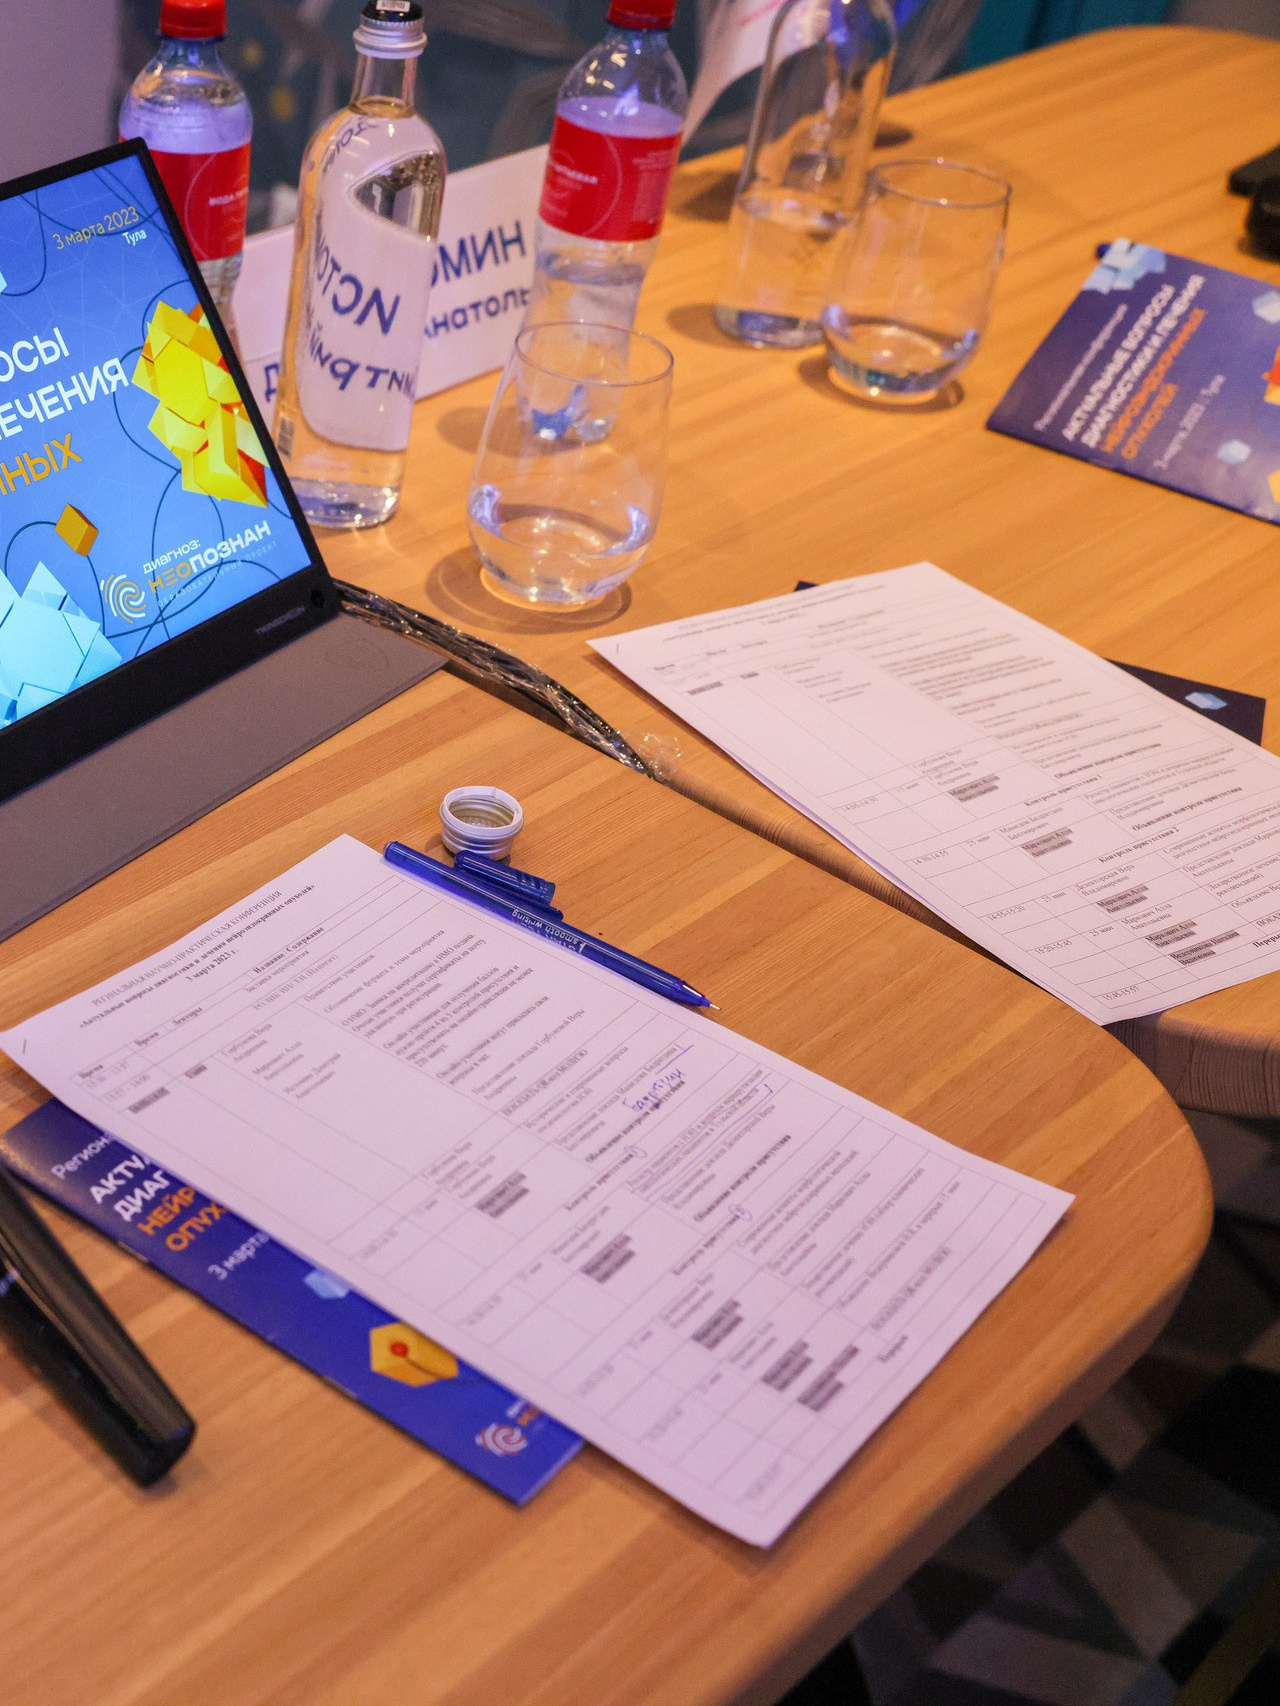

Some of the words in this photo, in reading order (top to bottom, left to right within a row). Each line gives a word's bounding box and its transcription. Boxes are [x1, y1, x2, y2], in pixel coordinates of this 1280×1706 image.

[52, 234, 65, 250] 3
[65, 222, 106, 248] марта
[103, 206, 140, 232] 2023
[122, 229, 147, 247] Тула
[431, 220, 526, 288] МИН
[1098, 847, 1135, 862] Контроль
[1130, 830, 1176, 848] присутствия
[1116, 864, 1135, 873] Вера
[1190, 858, 1235, 877] Анатольевны
[1097, 892, 1131, 907] Маркович
[1129, 885, 1148, 894] Алла
[1230, 889, 1272, 907] Объявление
[511, 908, 543, 929] writing
[1121, 910, 1156, 925] Маркович
[1153, 903, 1172, 912] Алла
[1129, 913, 1171, 930] Анатольевна
[544, 924, 578, 946] smooth
[1146, 927, 1179, 942] Маркович
[1177, 920, 1196, 929] Алла
[1154, 930, 1195, 947] Анатольевна
[191, 963, 216, 978] марта
[212, 952, 232, 964] 2023
[89, 1154, 151, 1204] АКТУ
[114, 1170, 170, 1222] ДИАГ
[137, 1185, 197, 1236] НЕЙР
[165, 1201, 230, 1252] ОПУХ
[208, 1263, 229, 1281] 3
